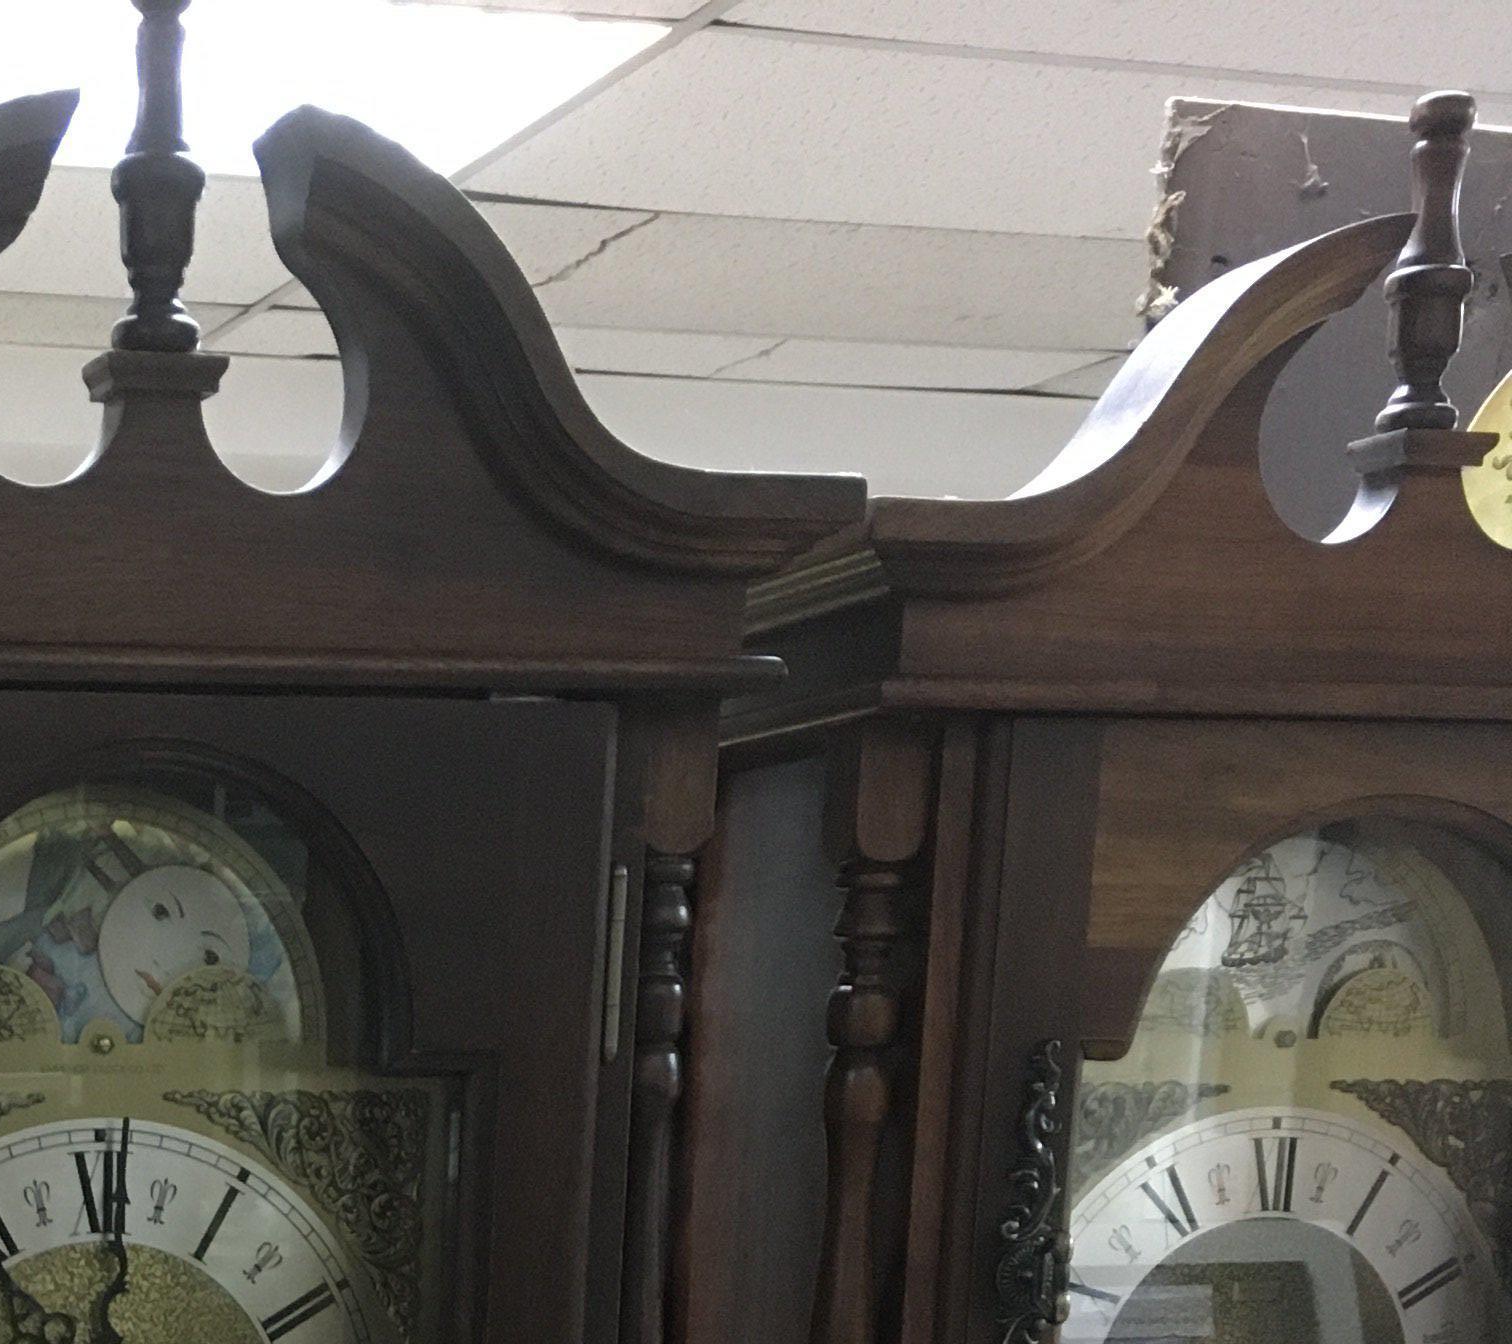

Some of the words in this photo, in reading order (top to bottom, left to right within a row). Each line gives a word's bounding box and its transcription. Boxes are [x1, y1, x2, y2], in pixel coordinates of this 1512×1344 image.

[1243, 1136, 1302, 1214] XII
[189, 1182, 244, 1265] I
[1397, 1255, 1464, 1310] II
